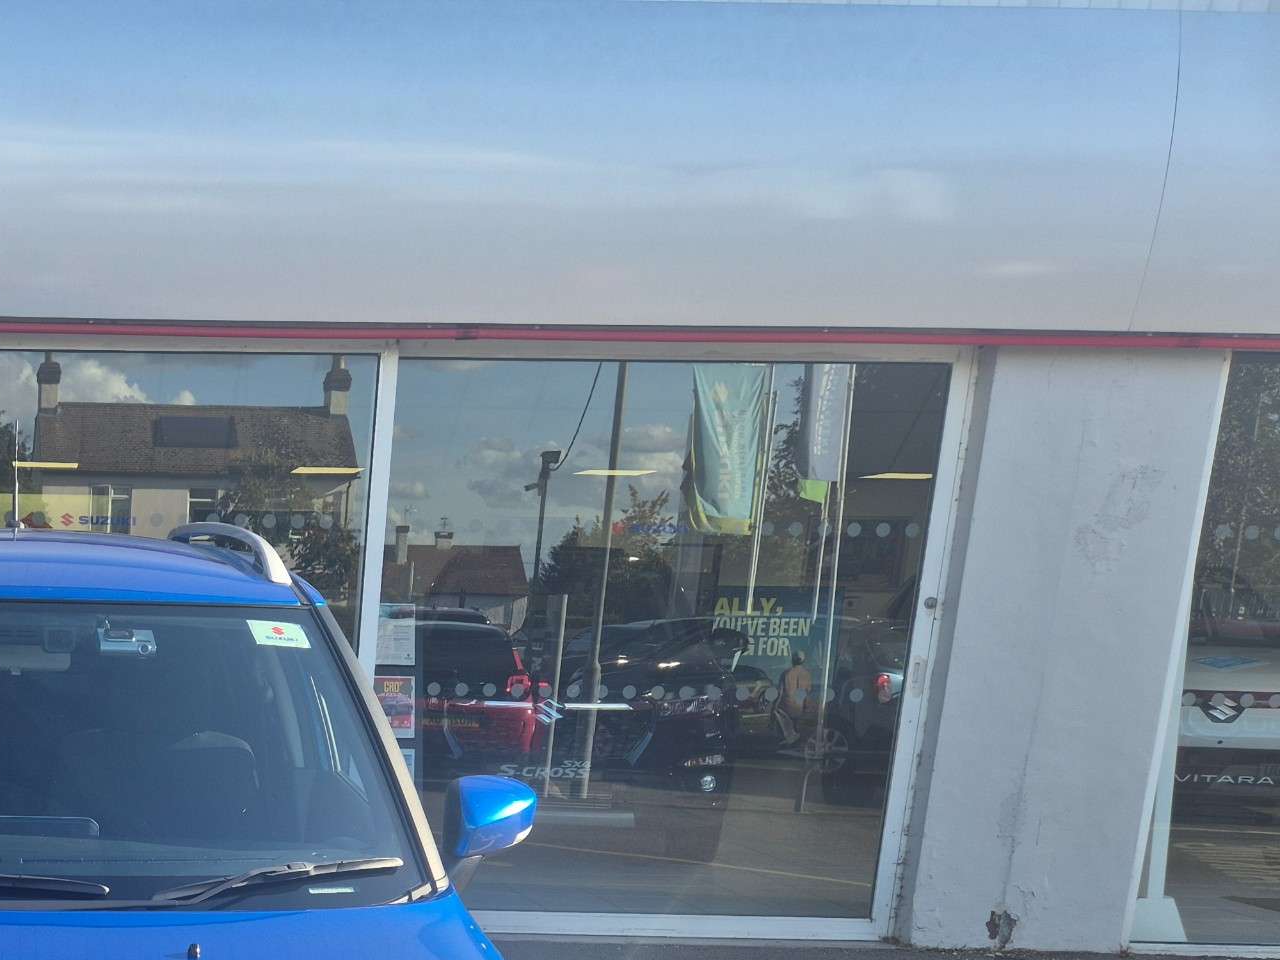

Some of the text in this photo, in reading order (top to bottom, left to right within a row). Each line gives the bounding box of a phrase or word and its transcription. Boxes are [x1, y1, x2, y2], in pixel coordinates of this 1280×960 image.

[78, 515, 136, 526] SUZUKI
[714, 597, 784, 616] ALLY,
[768, 617, 810, 637] BEEN
[757, 637, 792, 656] FOR
[496, 764, 590, 779] S-CROSS
[561, 760, 591, 768] SX4
[1175, 773, 1275, 785] VITARA
